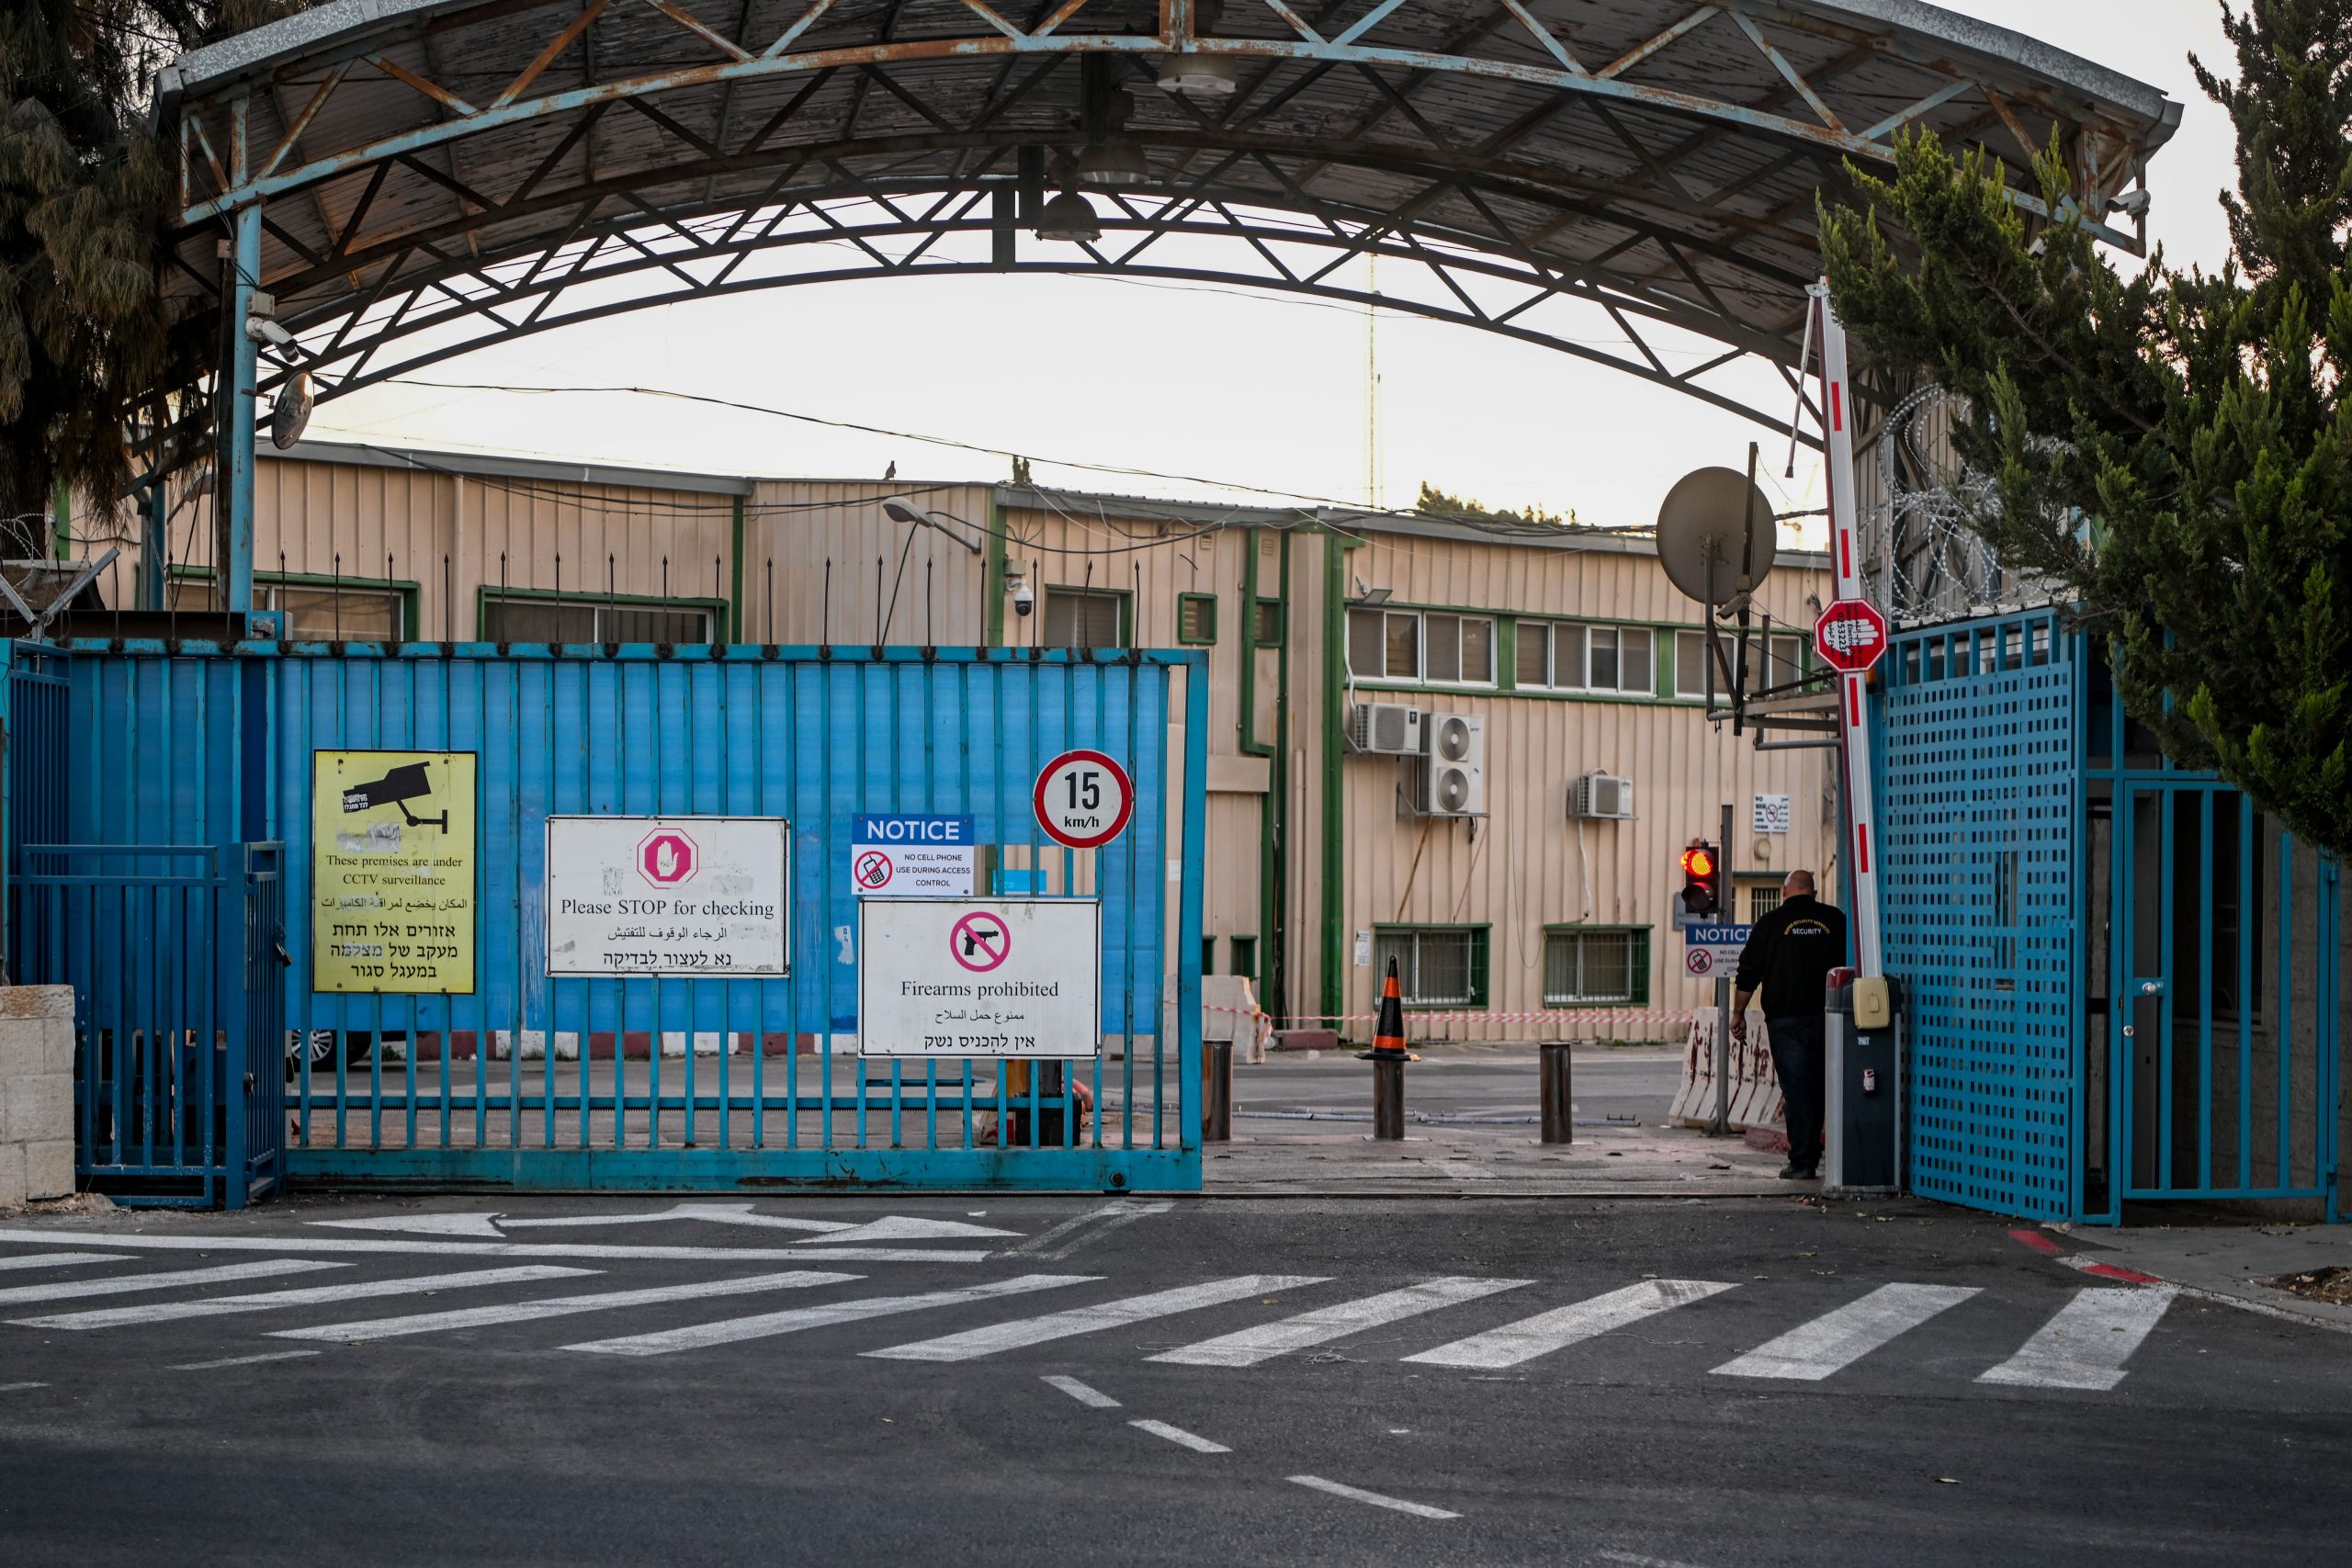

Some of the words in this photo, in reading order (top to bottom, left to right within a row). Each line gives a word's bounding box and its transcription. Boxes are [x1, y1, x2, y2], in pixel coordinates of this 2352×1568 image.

[1065, 772, 1099, 809] 15
[1065, 816, 1099, 829] km/h
[868, 820, 959, 840] NOTICE
[326, 855, 357, 865] These
[362, 856, 408, 867] premises
[434, 857, 462, 866] under
[344, 874, 378, 884] CCTV
[382, 875, 445, 885] surveillance
[405, 900, 435, 912] يخضع
[439, 898, 467, 910] المكان
[562, 899, 611, 914] Please
[619, 900, 666, 914] STOP
[674, 900, 696, 915] for
[703, 900, 774, 919] checking
[333, 924, 367, 936] תחת
[374, 922, 399, 936] אלו
[407, 925, 455, 937] אזורים
[608, 927, 645, 941] للتفتيش
[650, 927, 687, 941] الوقوف
[694, 928, 727, 942] الرجاء
[331, 942, 382, 956] מצלמה
[390, 942, 410, 957] של
[417, 946, 457, 959] מעקב
[603, 950, 659, 968] לבדיקה
[662, 950, 708, 967] לעצור
[714, 953, 732, 966] נא
[351, 965, 384, 977] סגור
[390, 962, 436, 978] במעגל
[902, 981, 970, 996] Firearms
[978, 982, 1057, 999] prohibited
[935, 1010, 966, 1023] السلاح
[970, 1010, 991, 1021] حمل
[995, 1011, 1024, 1024] ممنوع
[925, 1036, 952, 1050] נשק
[959, 1033, 1008, 1047] להכניס
[1015, 1036, 1035, 1051] אין
